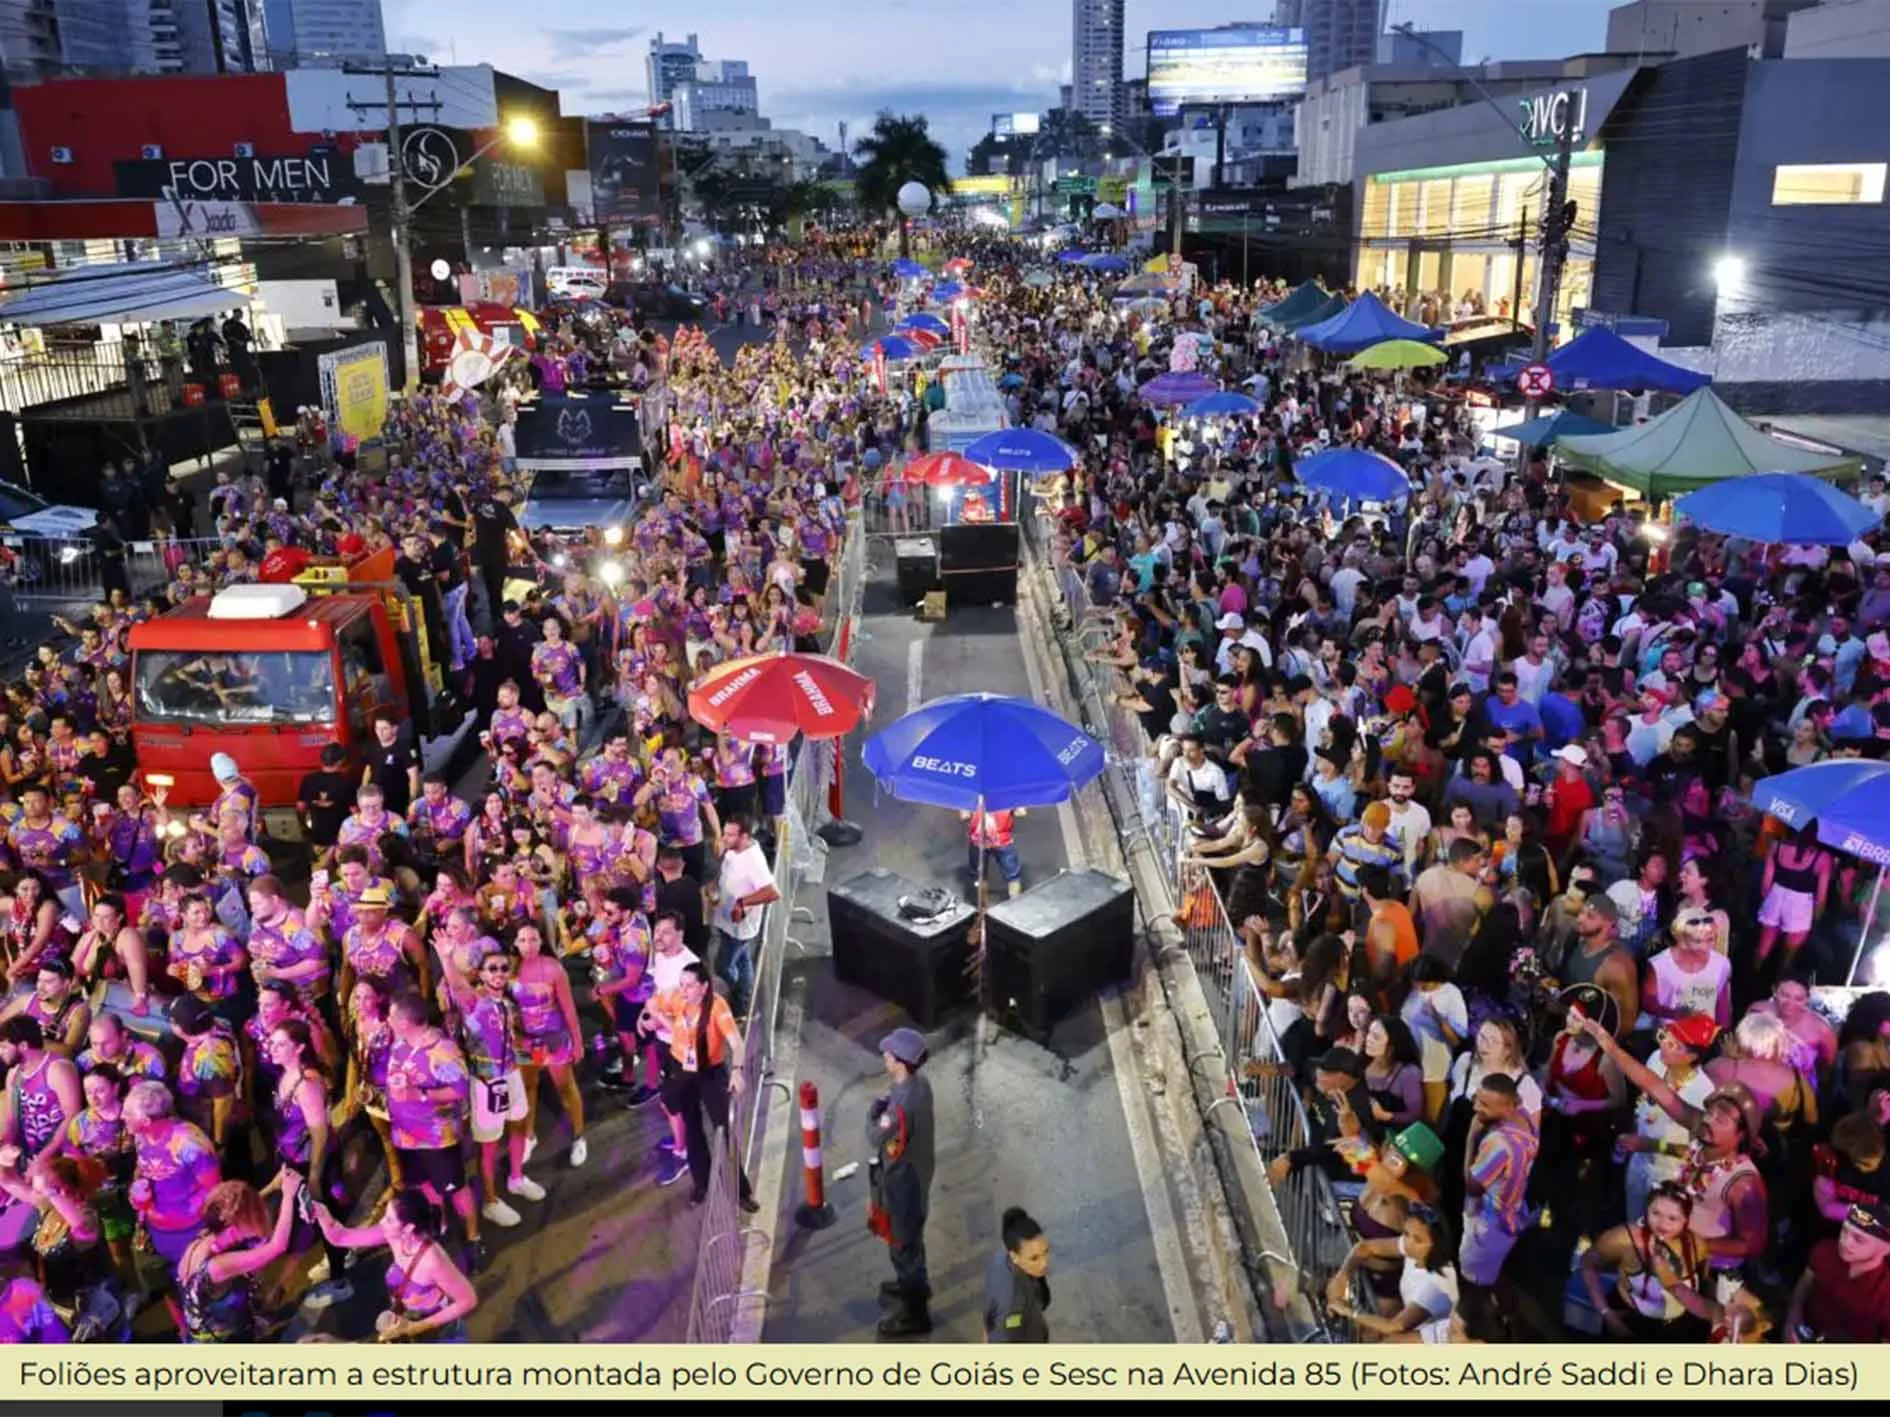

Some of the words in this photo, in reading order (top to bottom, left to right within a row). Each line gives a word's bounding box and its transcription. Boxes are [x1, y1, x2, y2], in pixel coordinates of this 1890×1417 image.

[169, 160, 240, 192] FOR
[252, 158, 331, 190] MEN
[708, 667, 762, 708] BRAHMA
[792, 669, 835, 717] BRAHMA
[912, 755, 977, 778] BEATS
